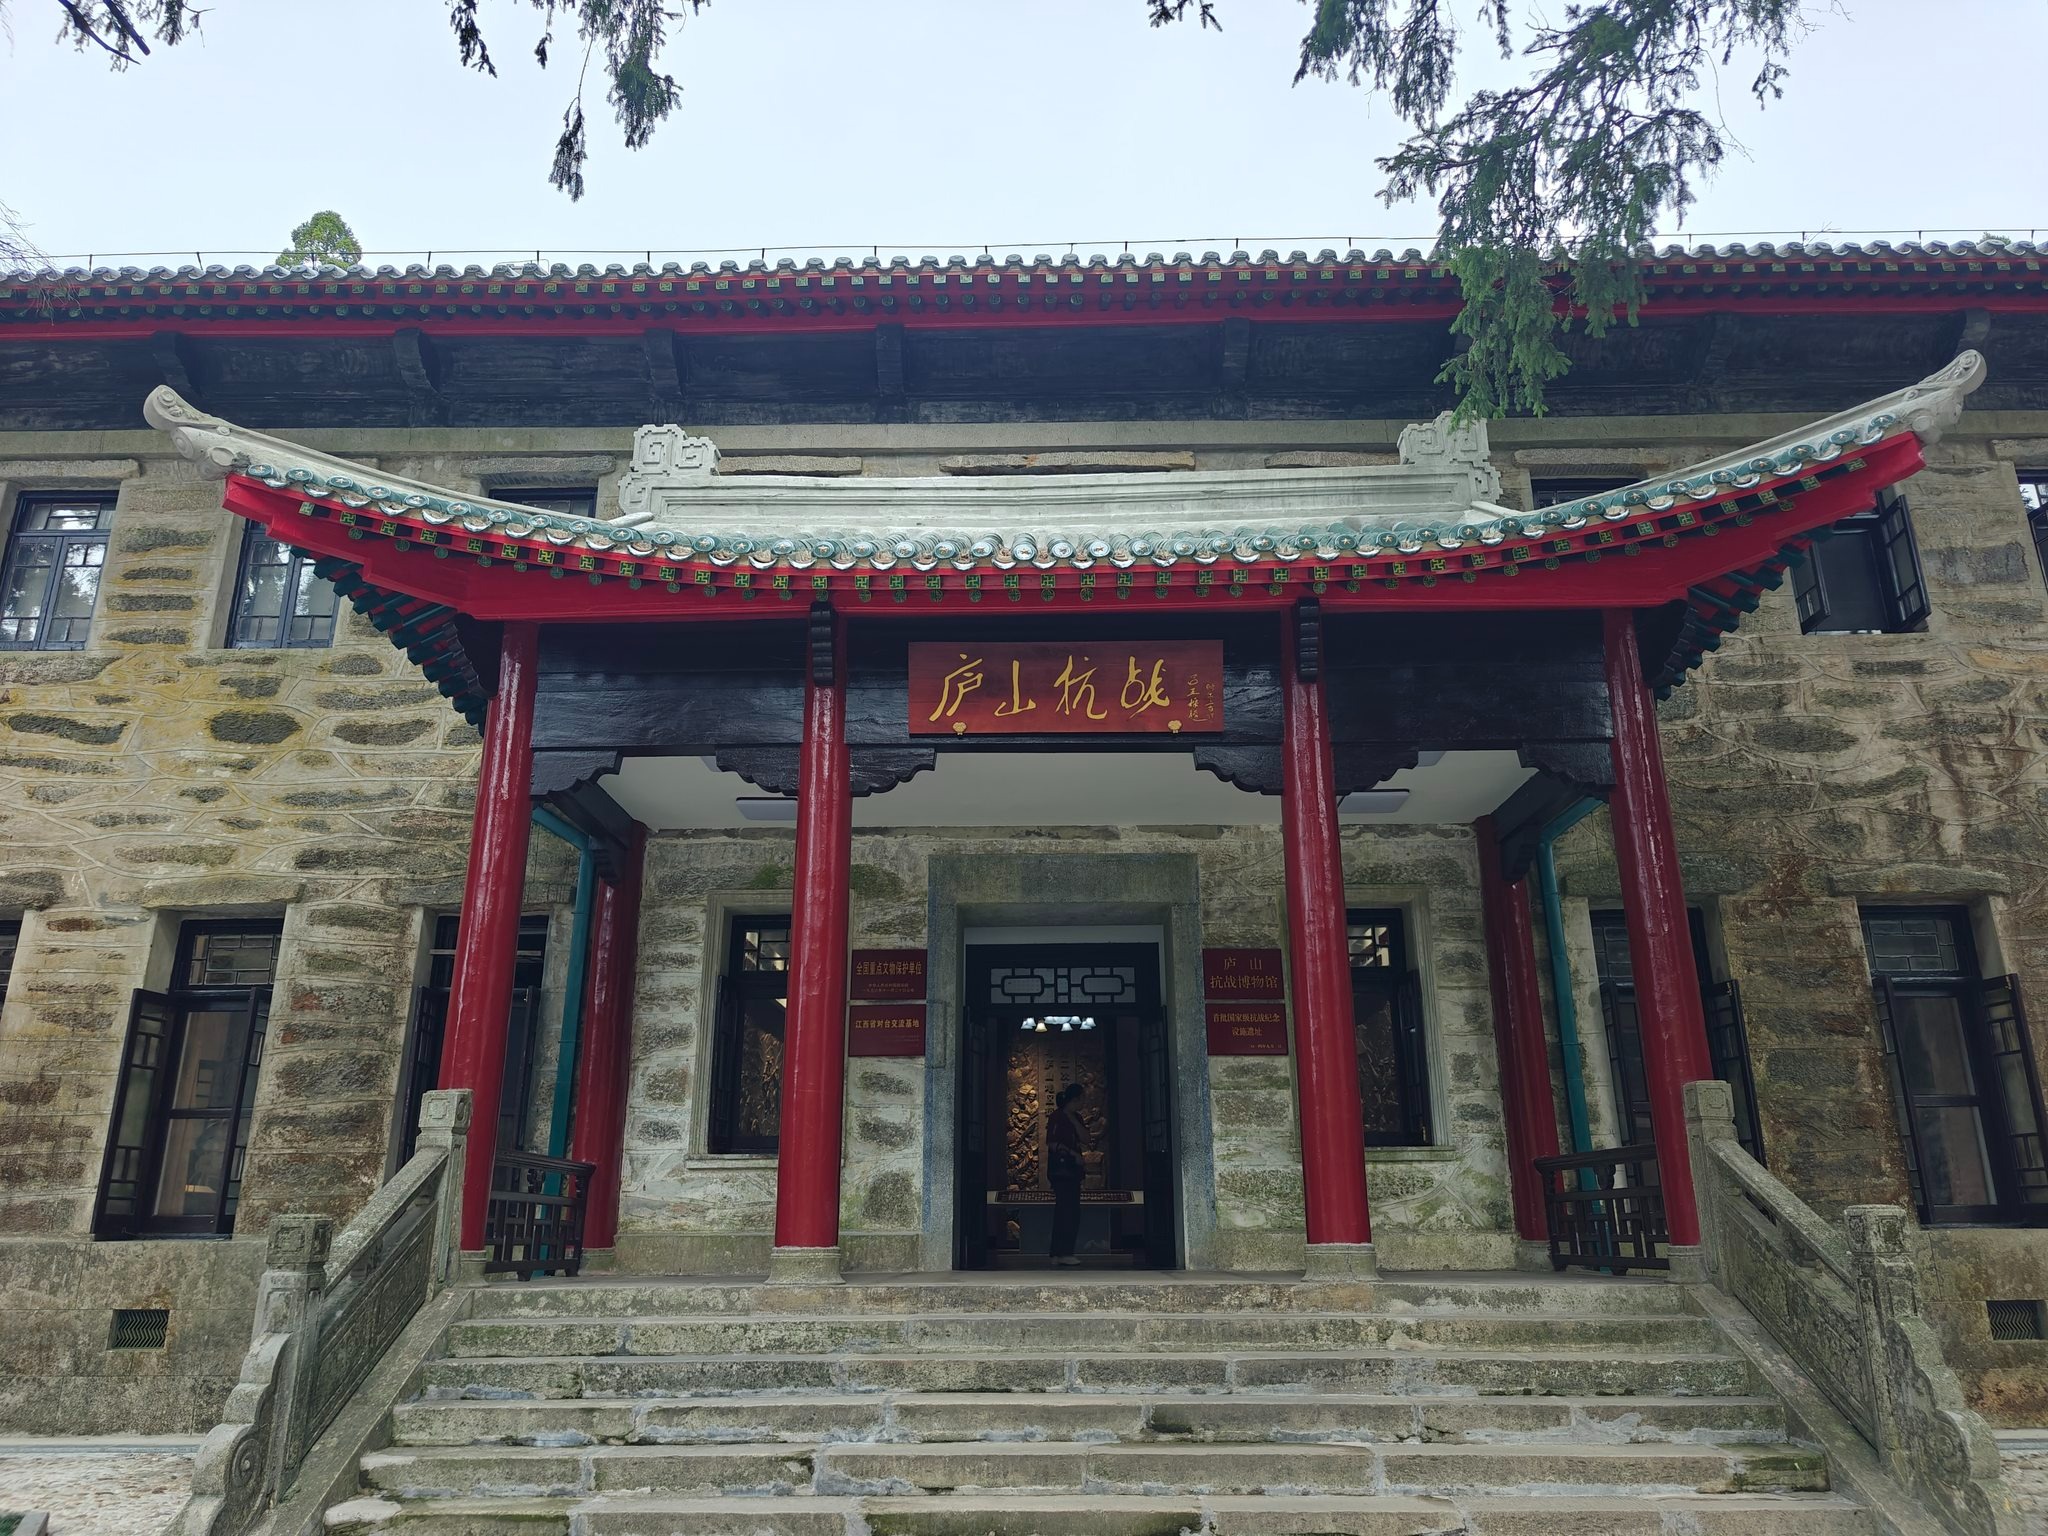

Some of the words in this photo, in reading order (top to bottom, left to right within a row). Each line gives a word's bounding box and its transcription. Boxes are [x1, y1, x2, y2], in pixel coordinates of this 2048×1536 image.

[856, 961, 922, 976] 全国重点文物保护单位
[1209, 975, 1278, 989] 抗战博物馆
[855, 1018, 920, 1029] 江西省对台交流基地
